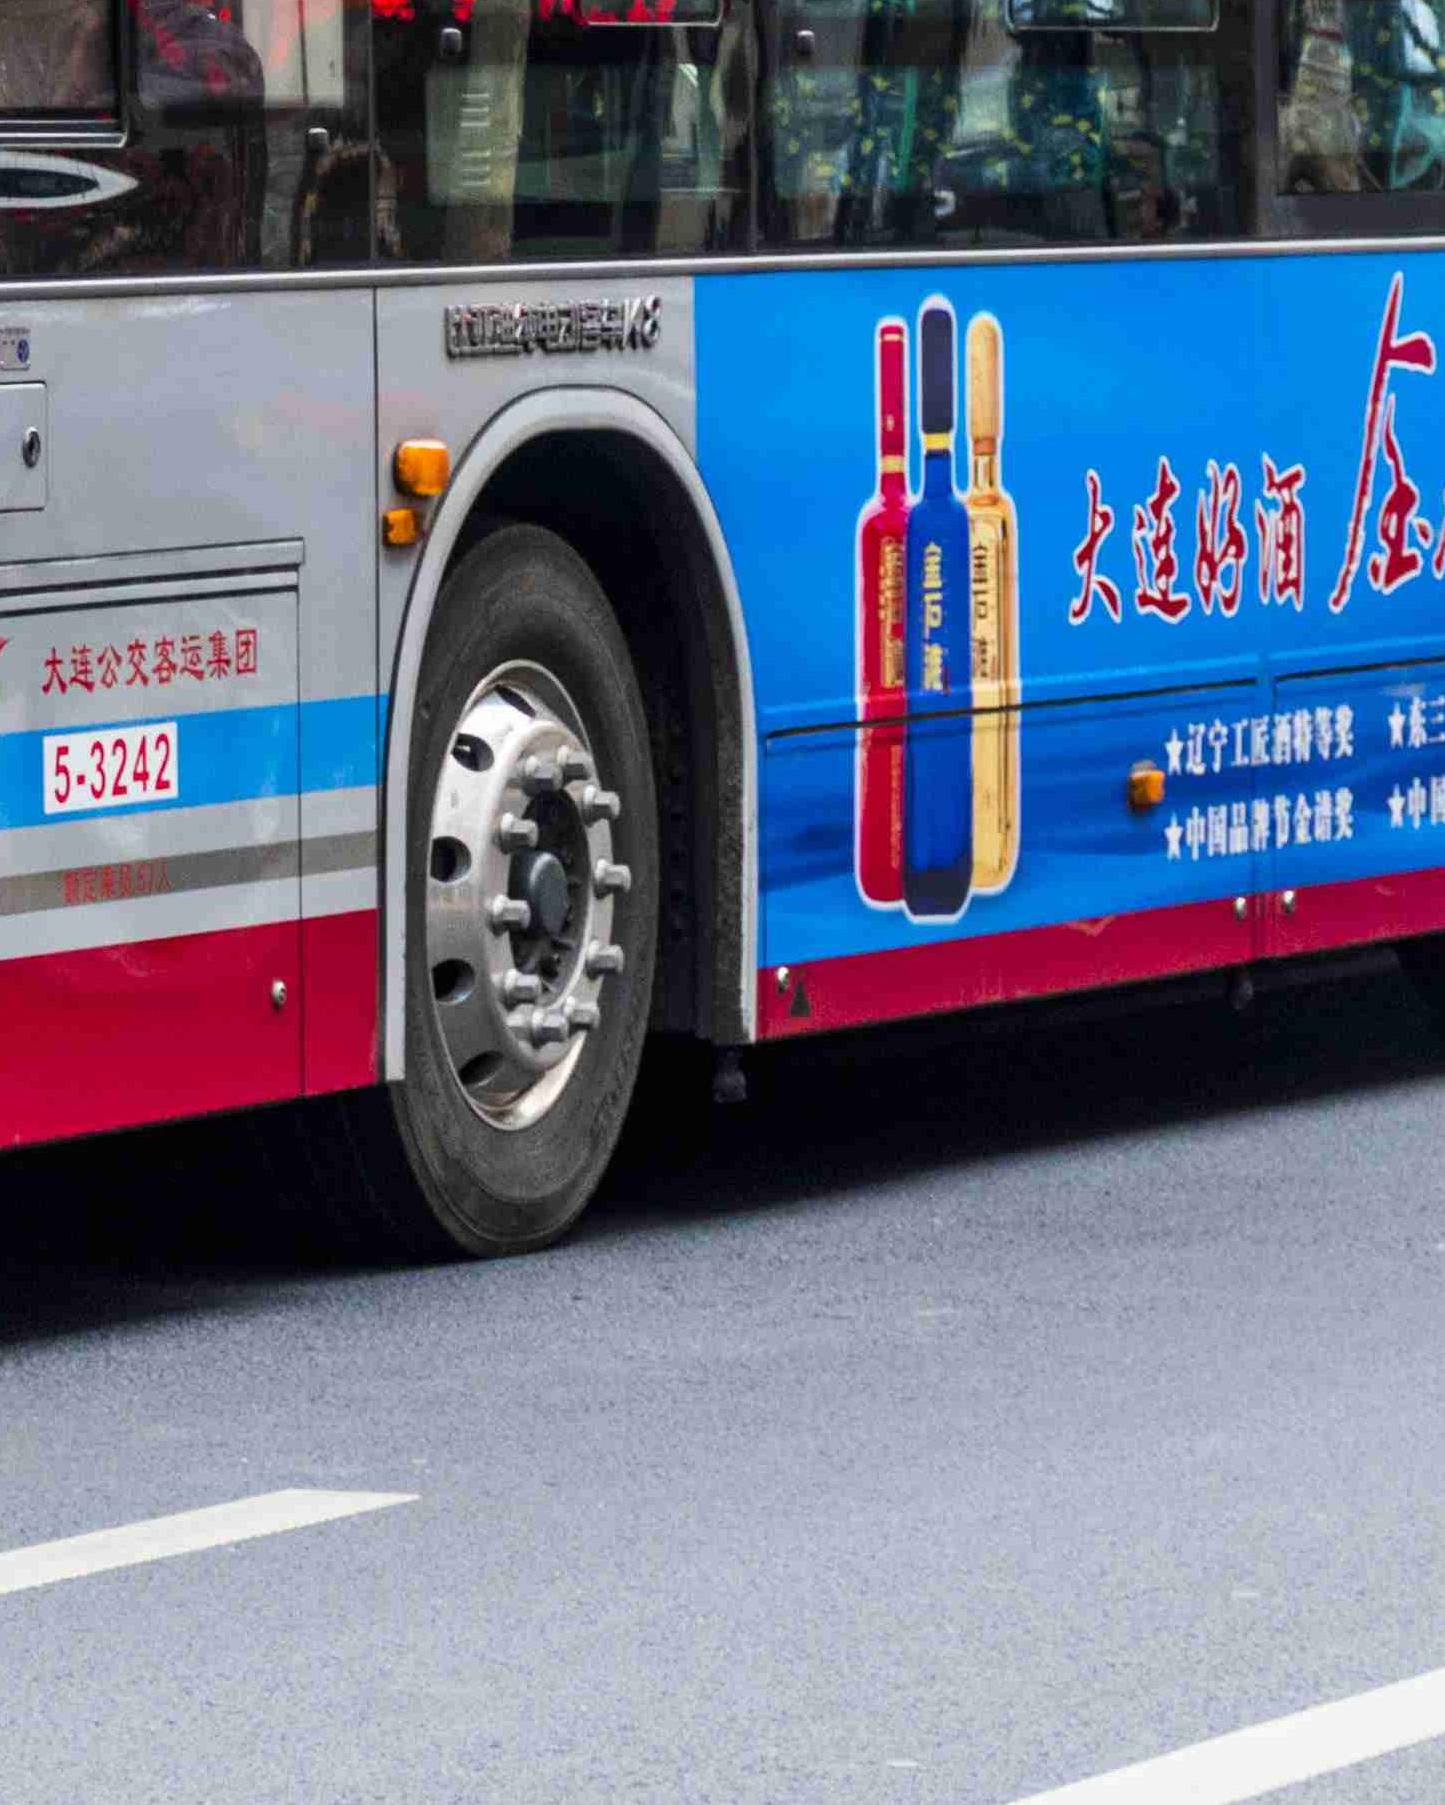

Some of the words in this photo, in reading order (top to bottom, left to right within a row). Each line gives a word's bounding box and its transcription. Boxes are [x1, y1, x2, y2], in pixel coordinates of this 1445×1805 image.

[1071, 454, 1305, 623] 大连好酒
[42, 629, 258, 695] 大连公交客运集团
[54, 732, 172, 804] 5-3242
